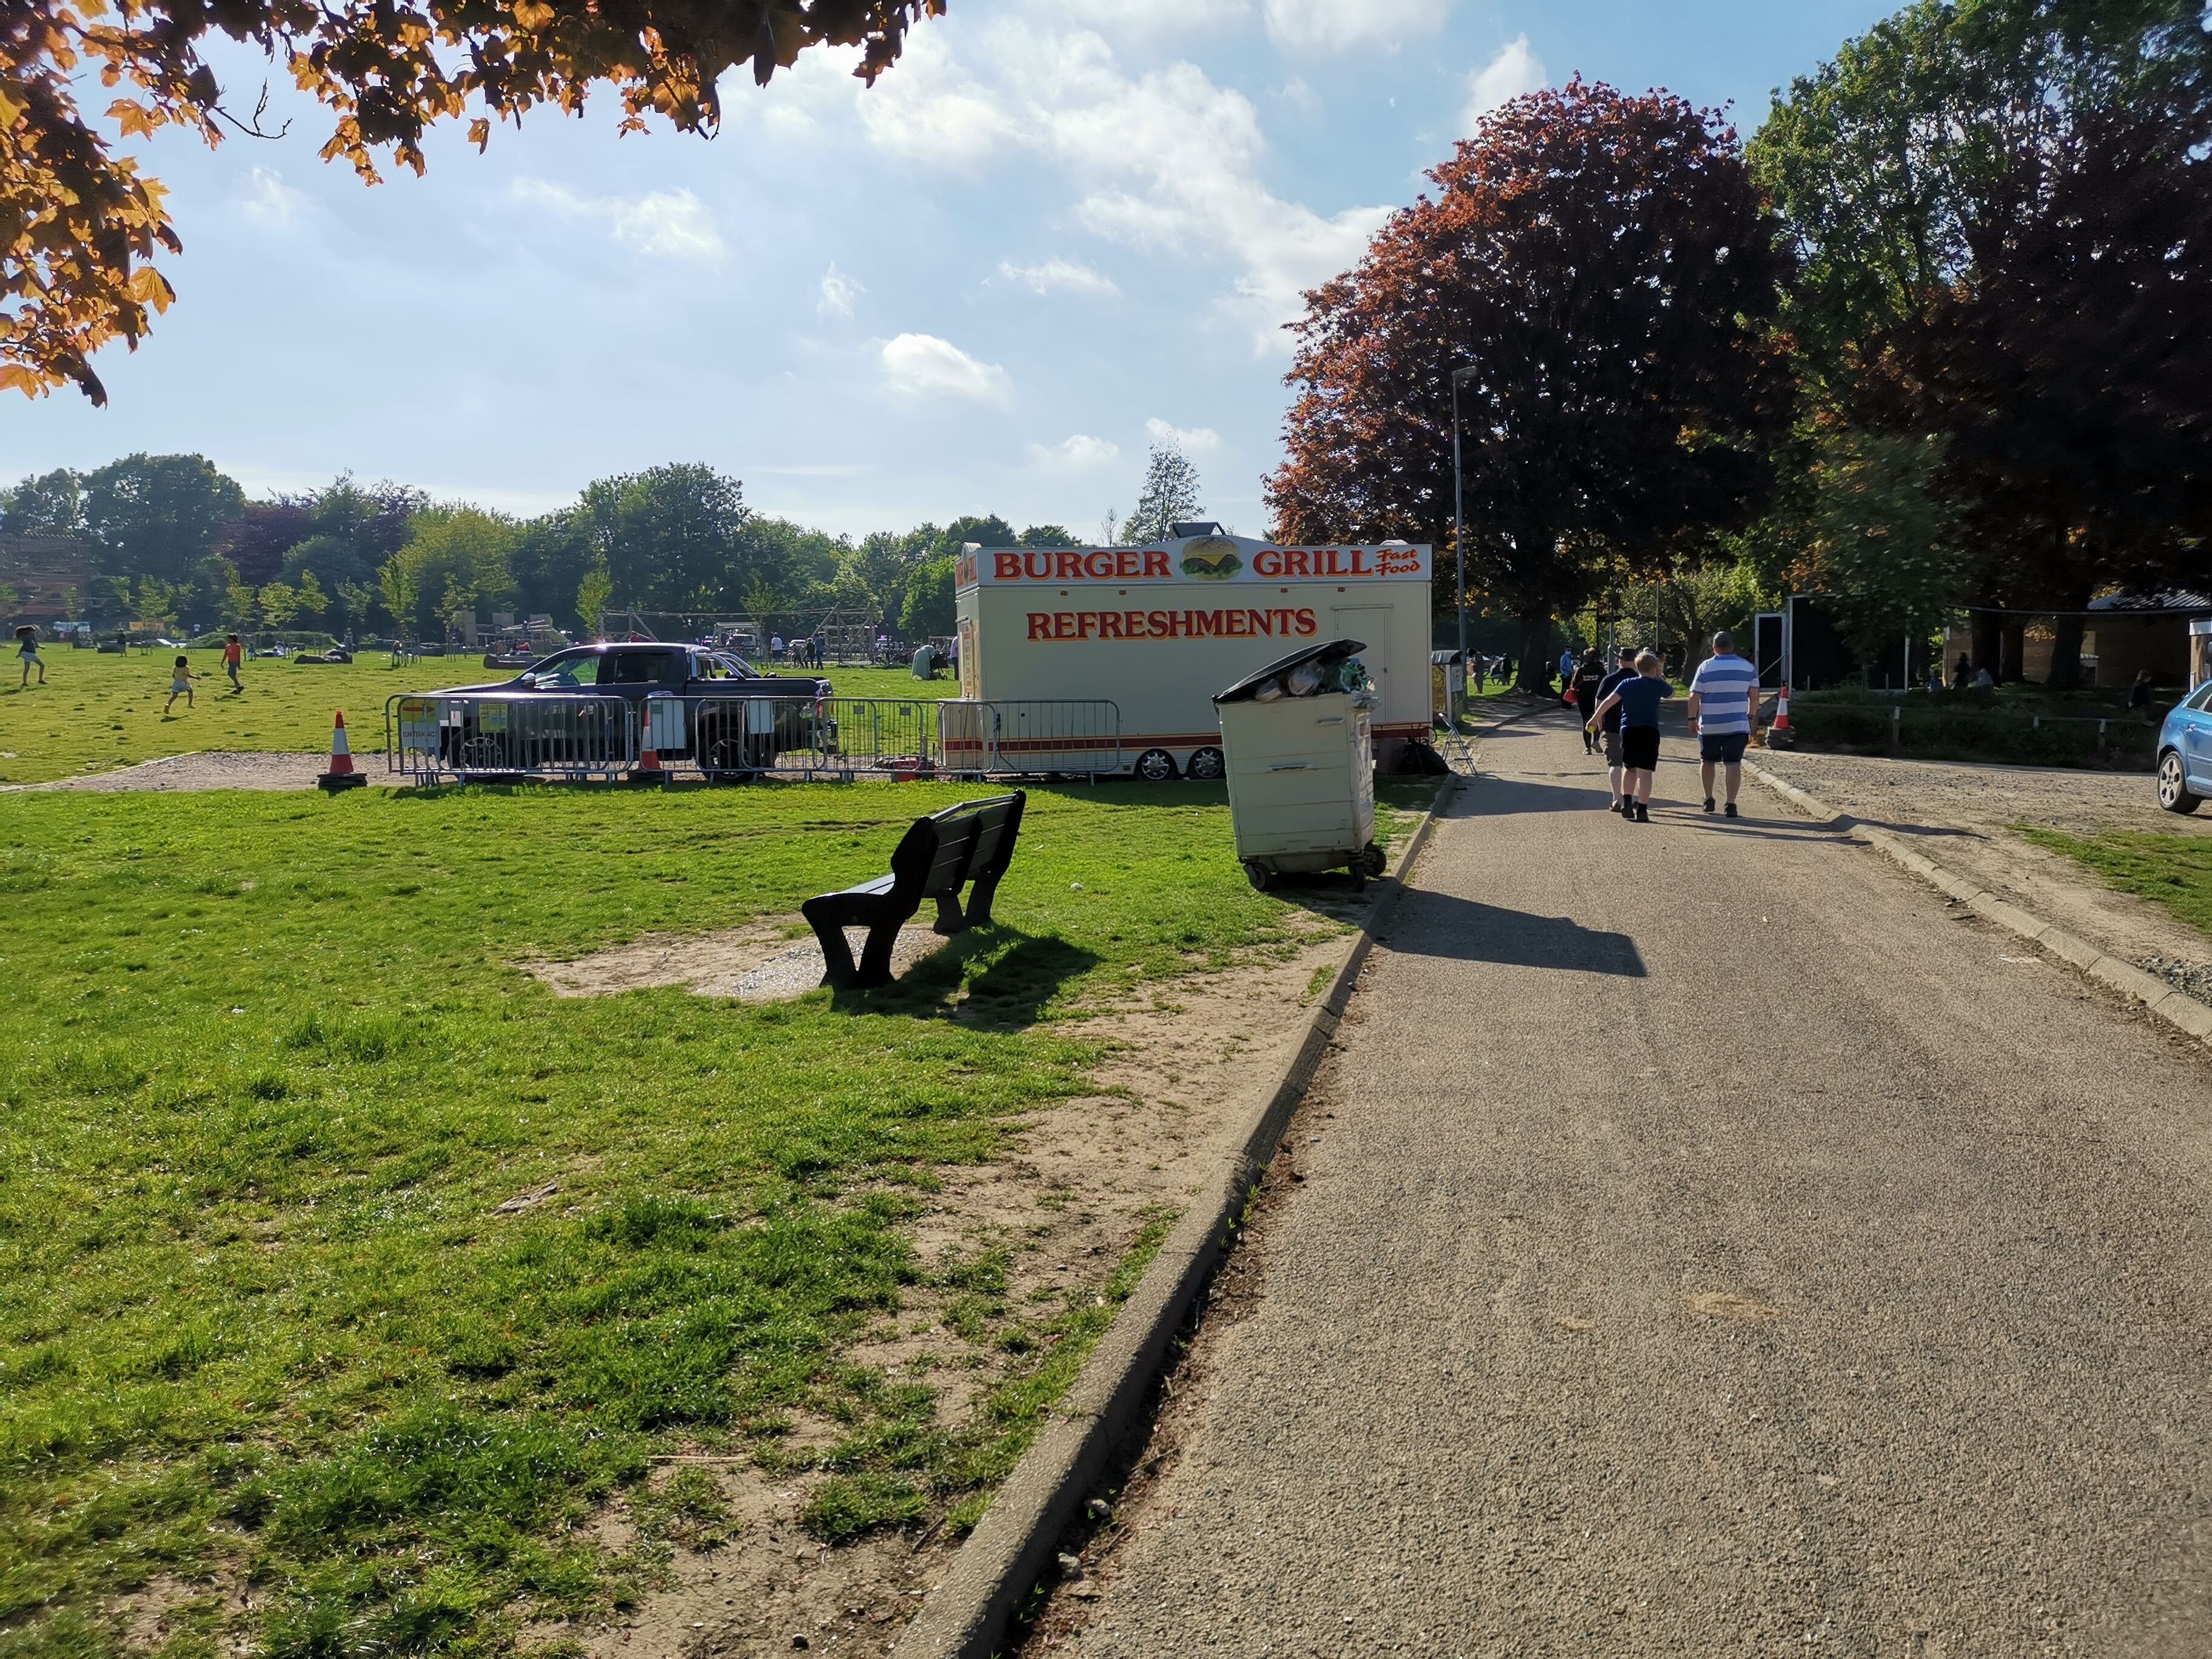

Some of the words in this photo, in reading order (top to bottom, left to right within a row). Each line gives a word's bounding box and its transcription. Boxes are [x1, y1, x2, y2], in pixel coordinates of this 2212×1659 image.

[993, 551, 1173, 581] BURGER
[1252, 549, 1375, 578] GRILL
[1375, 548, 1418, 563] Fast
[1374, 560, 1421, 578] Food
[1026, 608, 1319, 642] REFRESHMENTS
